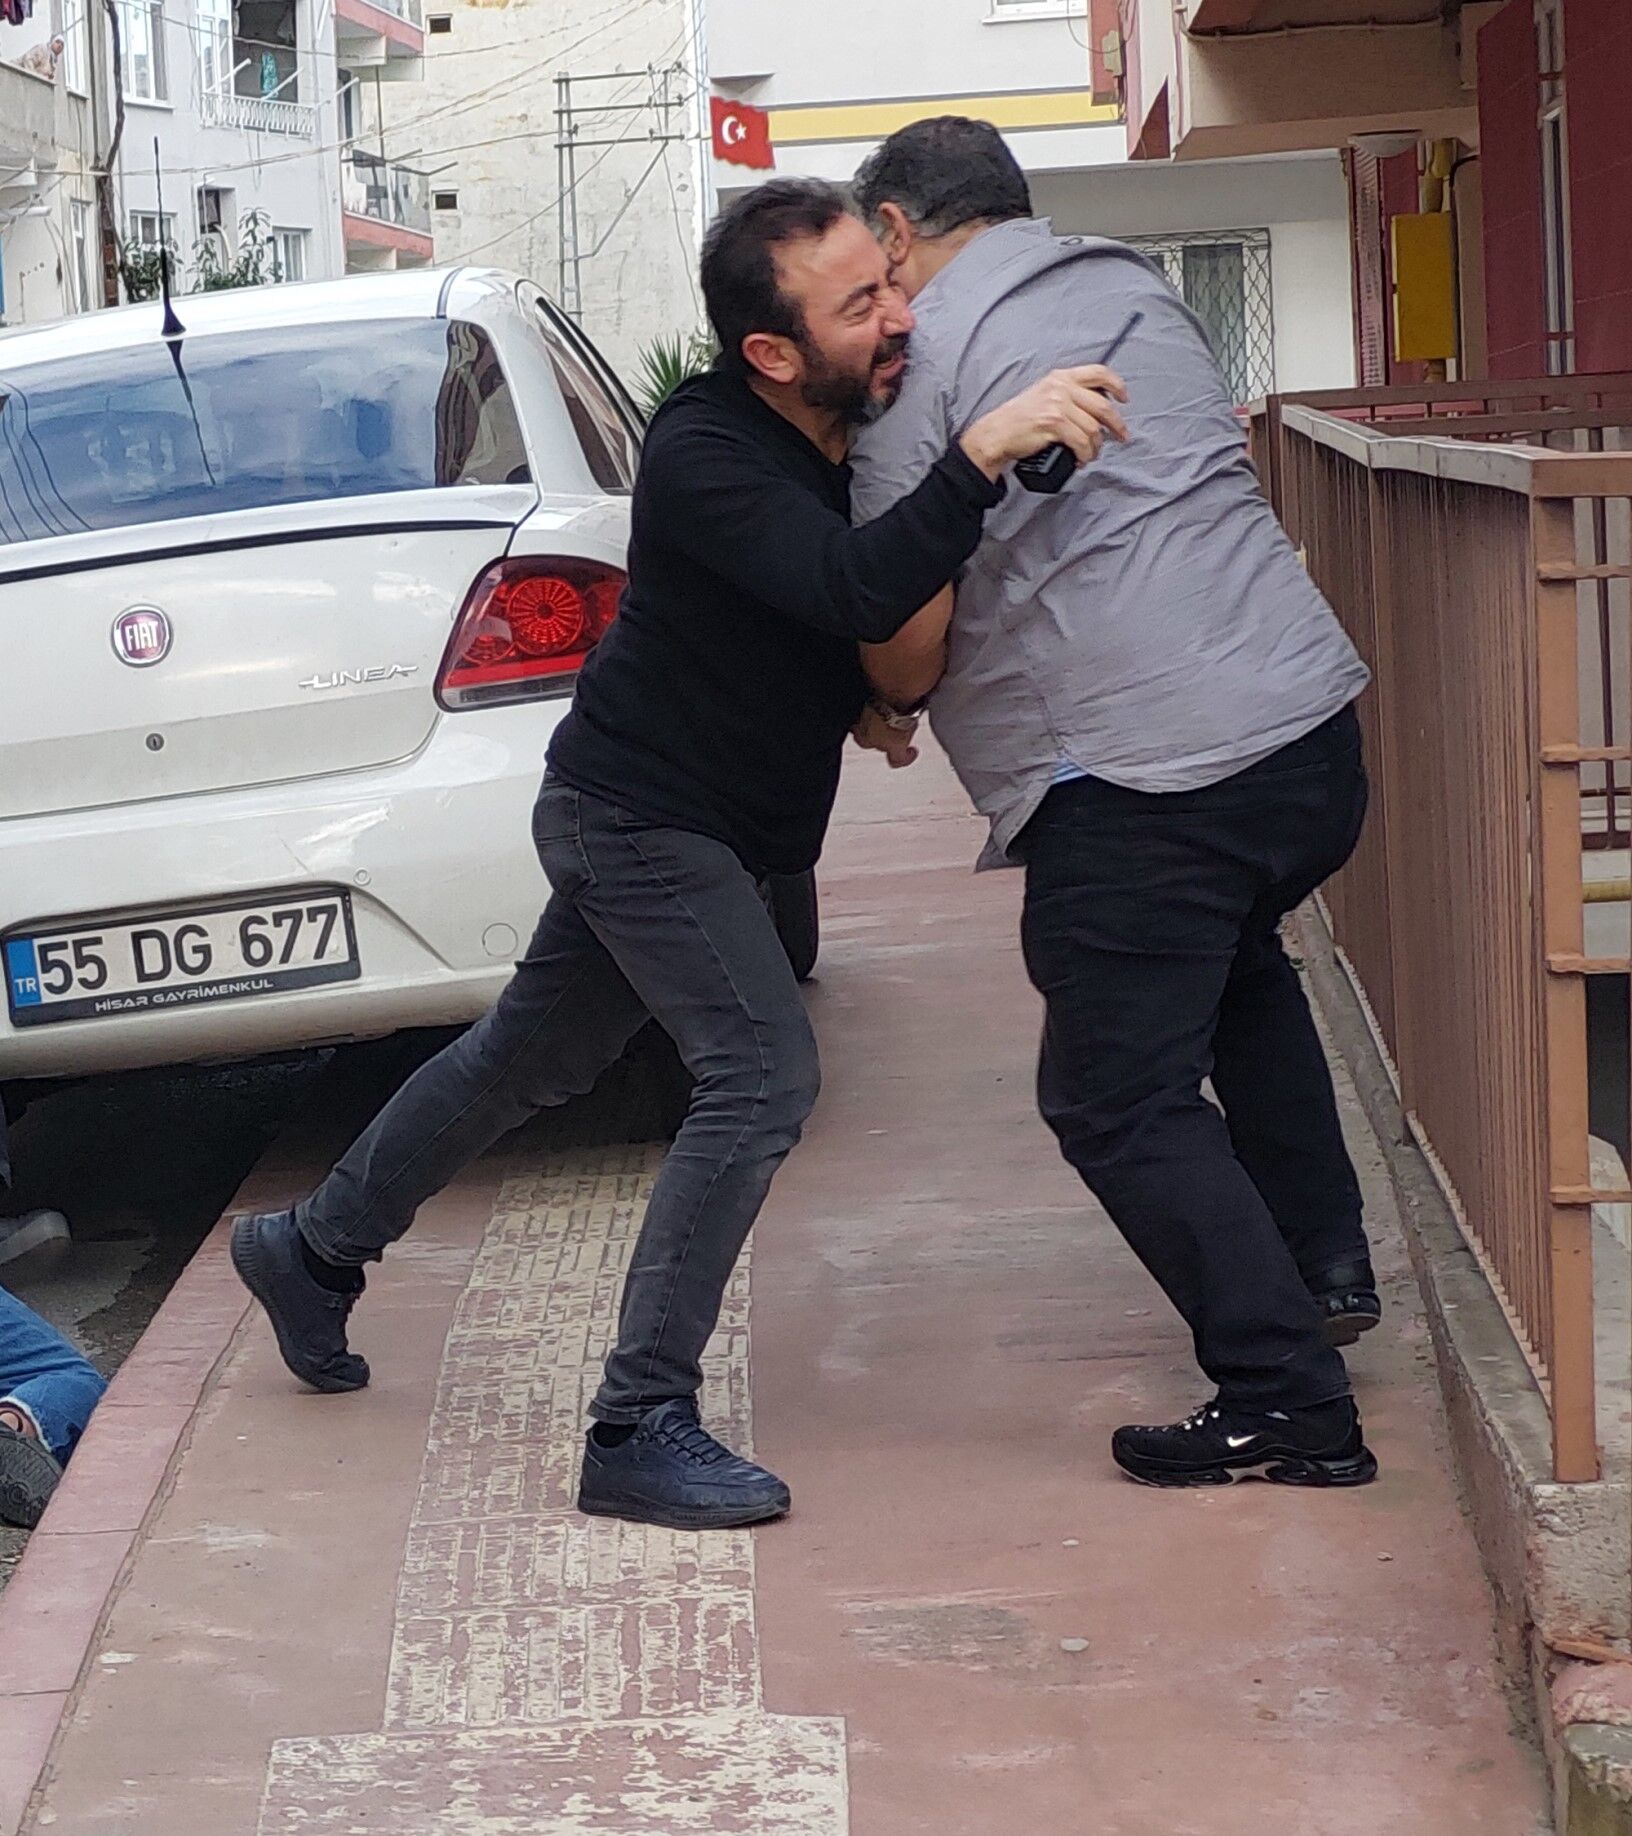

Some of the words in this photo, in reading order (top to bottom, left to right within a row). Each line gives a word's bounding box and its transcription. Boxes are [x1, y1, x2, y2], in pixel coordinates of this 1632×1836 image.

[124, 620, 159, 651] FIAT
[299, 663, 418, 689] LINEA
[14, 977, 37, 994] TR
[37, 936, 108, 995] 55
[131, 924, 213, 983] DG
[239, 904, 339, 968] 677
[95, 994, 149, 1012] HİSAR
[152, 978, 274, 1005] GAYRİMENKUL
